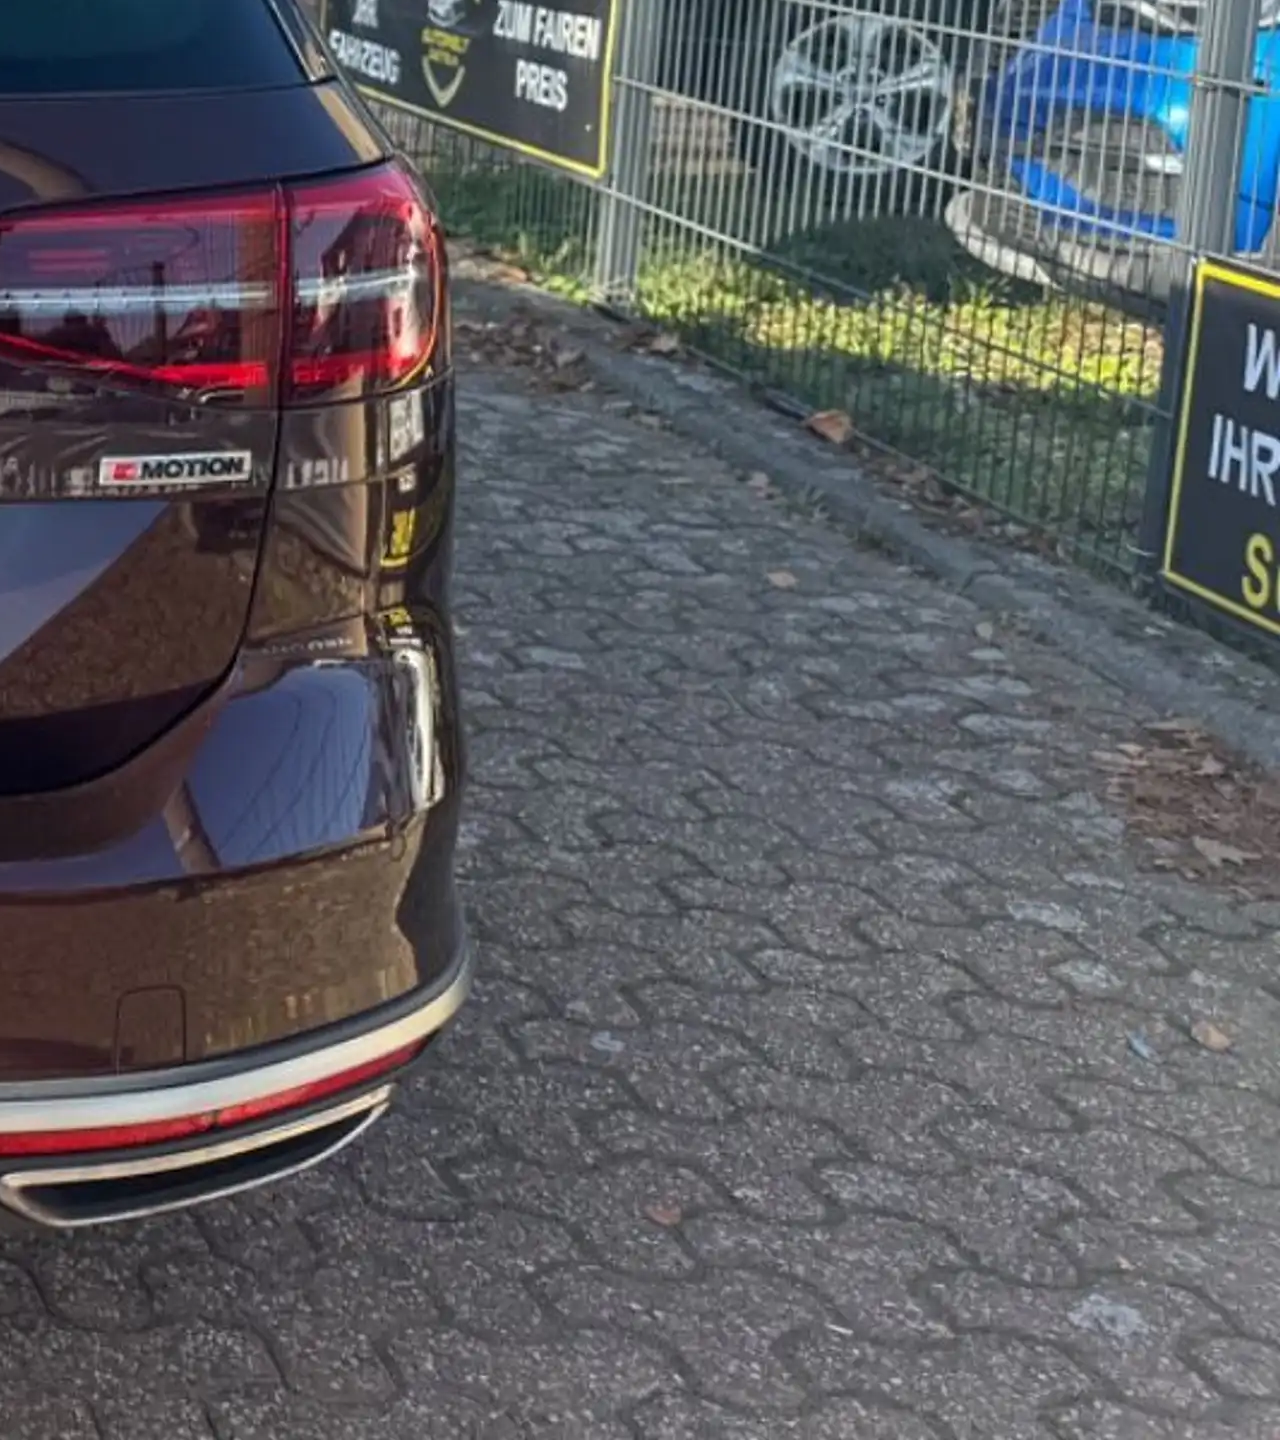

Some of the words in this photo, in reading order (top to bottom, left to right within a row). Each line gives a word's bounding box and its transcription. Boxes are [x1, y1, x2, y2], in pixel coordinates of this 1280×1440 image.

[533, 6, 603, 61] FAIREN
[514, 59, 569, 112] PREIS
[1241, 532, 1280, 610] S
